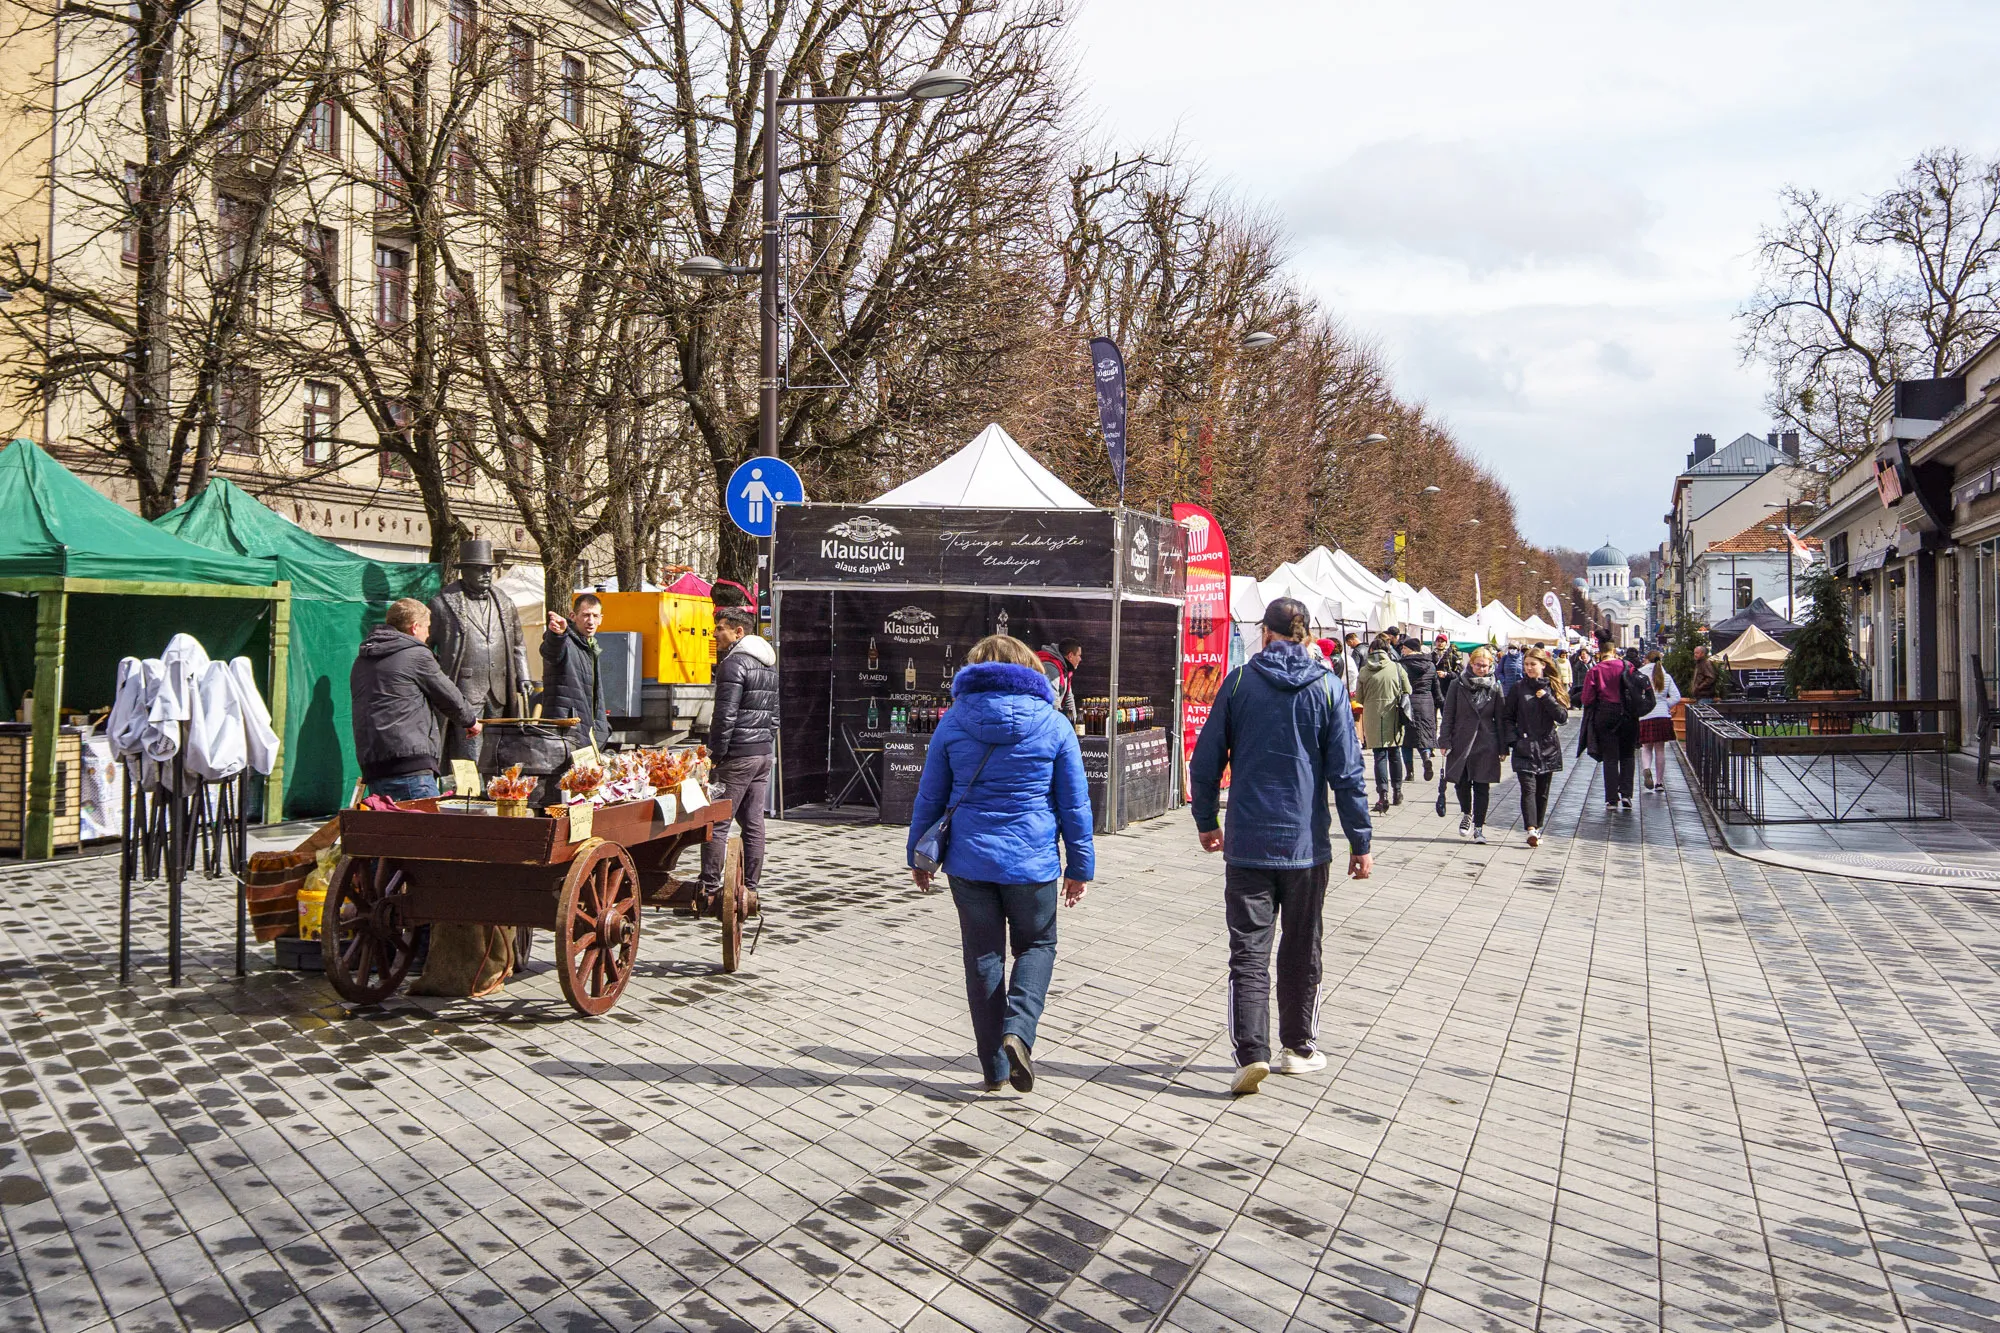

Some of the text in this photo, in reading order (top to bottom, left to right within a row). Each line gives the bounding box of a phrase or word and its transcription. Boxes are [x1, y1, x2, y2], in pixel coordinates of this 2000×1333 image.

[939, 530, 1003, 556] Teisingos
[820, 540, 904, 565] Klausučių
[834, 561, 891, 575] alaus darykla
[983, 556, 1040, 575] tradicijos
[884, 621, 939, 639] Klausučių
[885, 742, 914, 750] CANABIS
